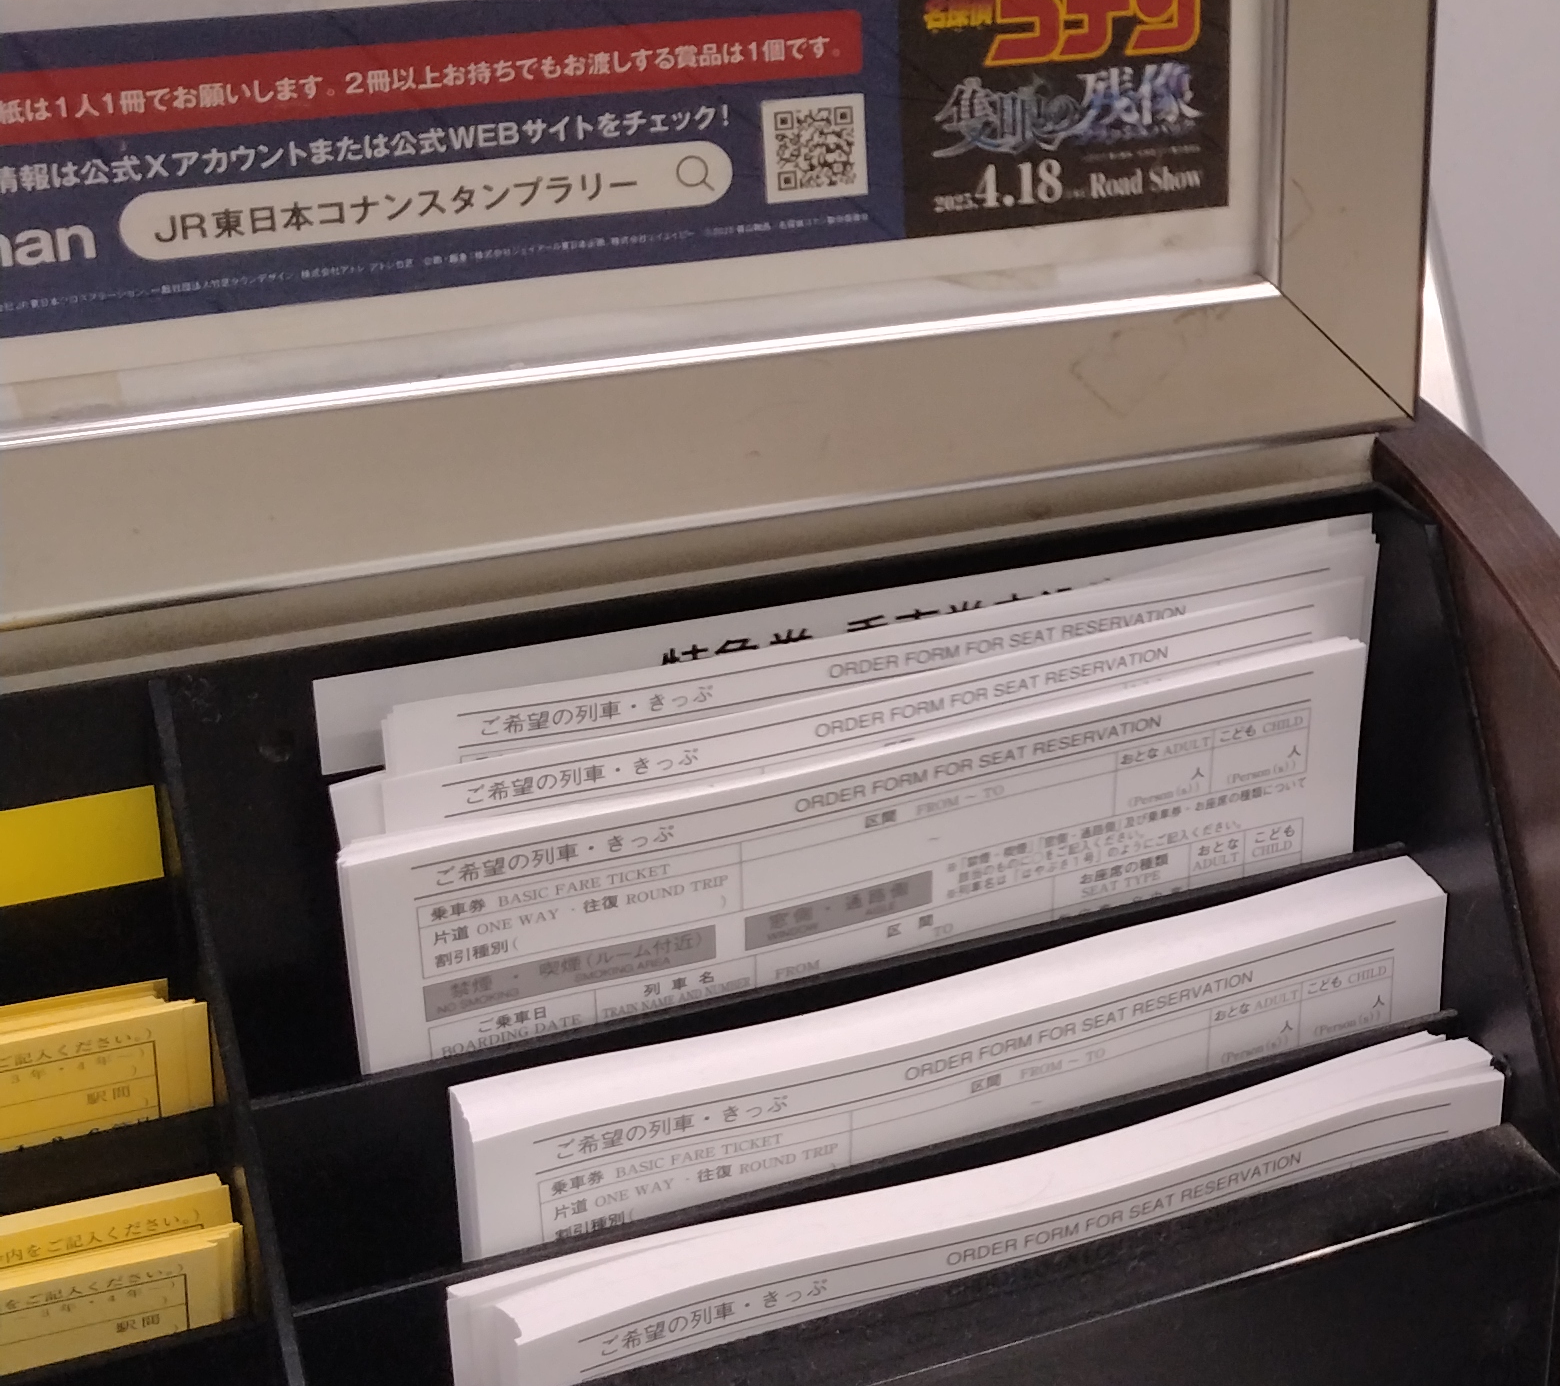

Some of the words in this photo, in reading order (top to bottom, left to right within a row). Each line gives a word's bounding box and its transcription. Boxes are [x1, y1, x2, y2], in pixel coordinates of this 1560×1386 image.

[154, 172, 638, 244] JR東日本コナンスタンプラリー
[828, 654, 899, 680] ORDER
[904, 641, 961, 667] FORM
[965, 634, 1005, 659] FOR
[1007, 626, 1056, 651] SEAT
[1061, 604, 1187, 642] RESERVATION
[479, 685, 714, 738] ご希望の列車・きっぷ
[813, 712, 885, 740] ORDER
[889, 698, 946, 724] FORM
[950, 689, 989, 712] FOR
[992, 677, 1040, 702] SEAT
[1044, 644, 1170, 690] RESERVATION
[464, 746, 700, 806] ご希望の列車・きっぷ
[793, 784, 867, 814] ORDER
[870, 767, 929, 795] FORM
[932, 756, 975, 783] FOR
[978, 745, 1027, 772] SEAT
[1031, 714, 1163, 758] RESERVATION
[1119, 745, 1160, 765] おとな
[1162, 735, 1212, 757] ADULT
[1217, 723, 1259, 745] こども
[434, 824, 676, 889] ご希望の列車・きっぷ
[1197, 837, 1240, 857] おとな
[1254, 824, 1296, 845] こども
[430, 898, 487, 923] 乗車券
[497, 885, 550, 909] BASIC
[554, 875, 601, 897] FARE
[606, 862, 672, 887] TICKET
[432, 924, 471, 947] 片道
[475, 916, 513, 937] ONE
[517, 907, 560, 927] WAY
[581, 894, 620, 915] 往復
[625, 882, 686, 906] ROUND
[689, 872, 730, 892] TRIP
[478, 1005, 549, 1035] ご乗車日
[903, 1052, 974, 1082] ORDER
[978, 1030, 1034, 1061] FORM
[1038, 1021, 1077, 1048] FOR
[1081, 1007, 1129, 1033] SEAT
[1132, 969, 1254, 1016] RESERVATION
[1214, 1000, 1251, 1023] おとな
[1253, 988, 1299, 1011] ADULT
[1306, 975, 1344, 996] こども
[1347, 964, 1389, 985] CHILD
[440, 1023, 530, 1059] BOARDING
[531, 1012, 582, 1036] DATE
[555, 1093, 790, 1162] ご希望の列車・きっぷ
[550, 1169, 605, 1197] 乗車券
[615, 1154, 666, 1180] BASIC
[669, 1144, 716, 1168] FARE
[721, 1132, 785, 1156] TICKET
[553, 1197, 588, 1222] 片道
[593, 1189, 629, 1210] ONE
[634, 1178, 675, 1198] WAY
[696, 1162, 734, 1184] 往復
[738, 1151, 798, 1176] ROUND
[801, 1140, 839, 1162] TRIP
[946, 1238, 1018, 1268] ORDER
[1023, 1222, 1081, 1250] FORM
[1084, 1209, 1125, 1234] FOR
[1128, 1195, 1176, 1220] SEAT
[1180, 1151, 1303, 1204] RESERVATION
[599, 1277, 829, 1358] ご希望の列車・きっぷ
